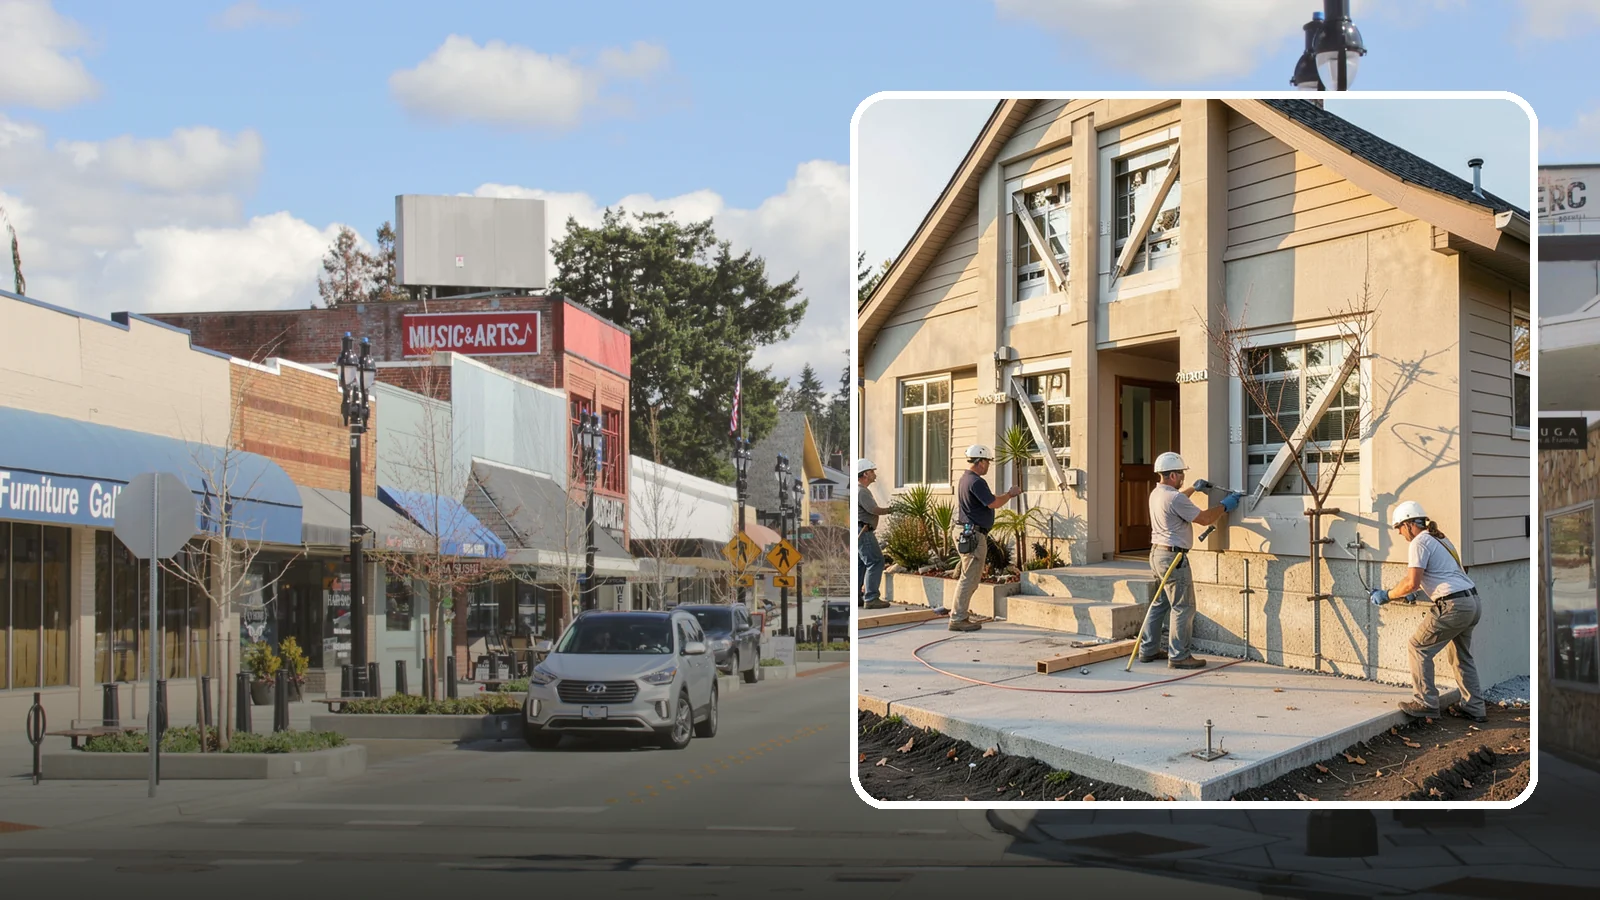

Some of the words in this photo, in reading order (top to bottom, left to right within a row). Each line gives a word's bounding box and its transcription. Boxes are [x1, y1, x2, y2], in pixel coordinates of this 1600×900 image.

[409, 323, 519, 348] MUSIC&ARTS
[1541, 428, 1577, 436] UGA
[0, 472, 79, 515] Furniture
